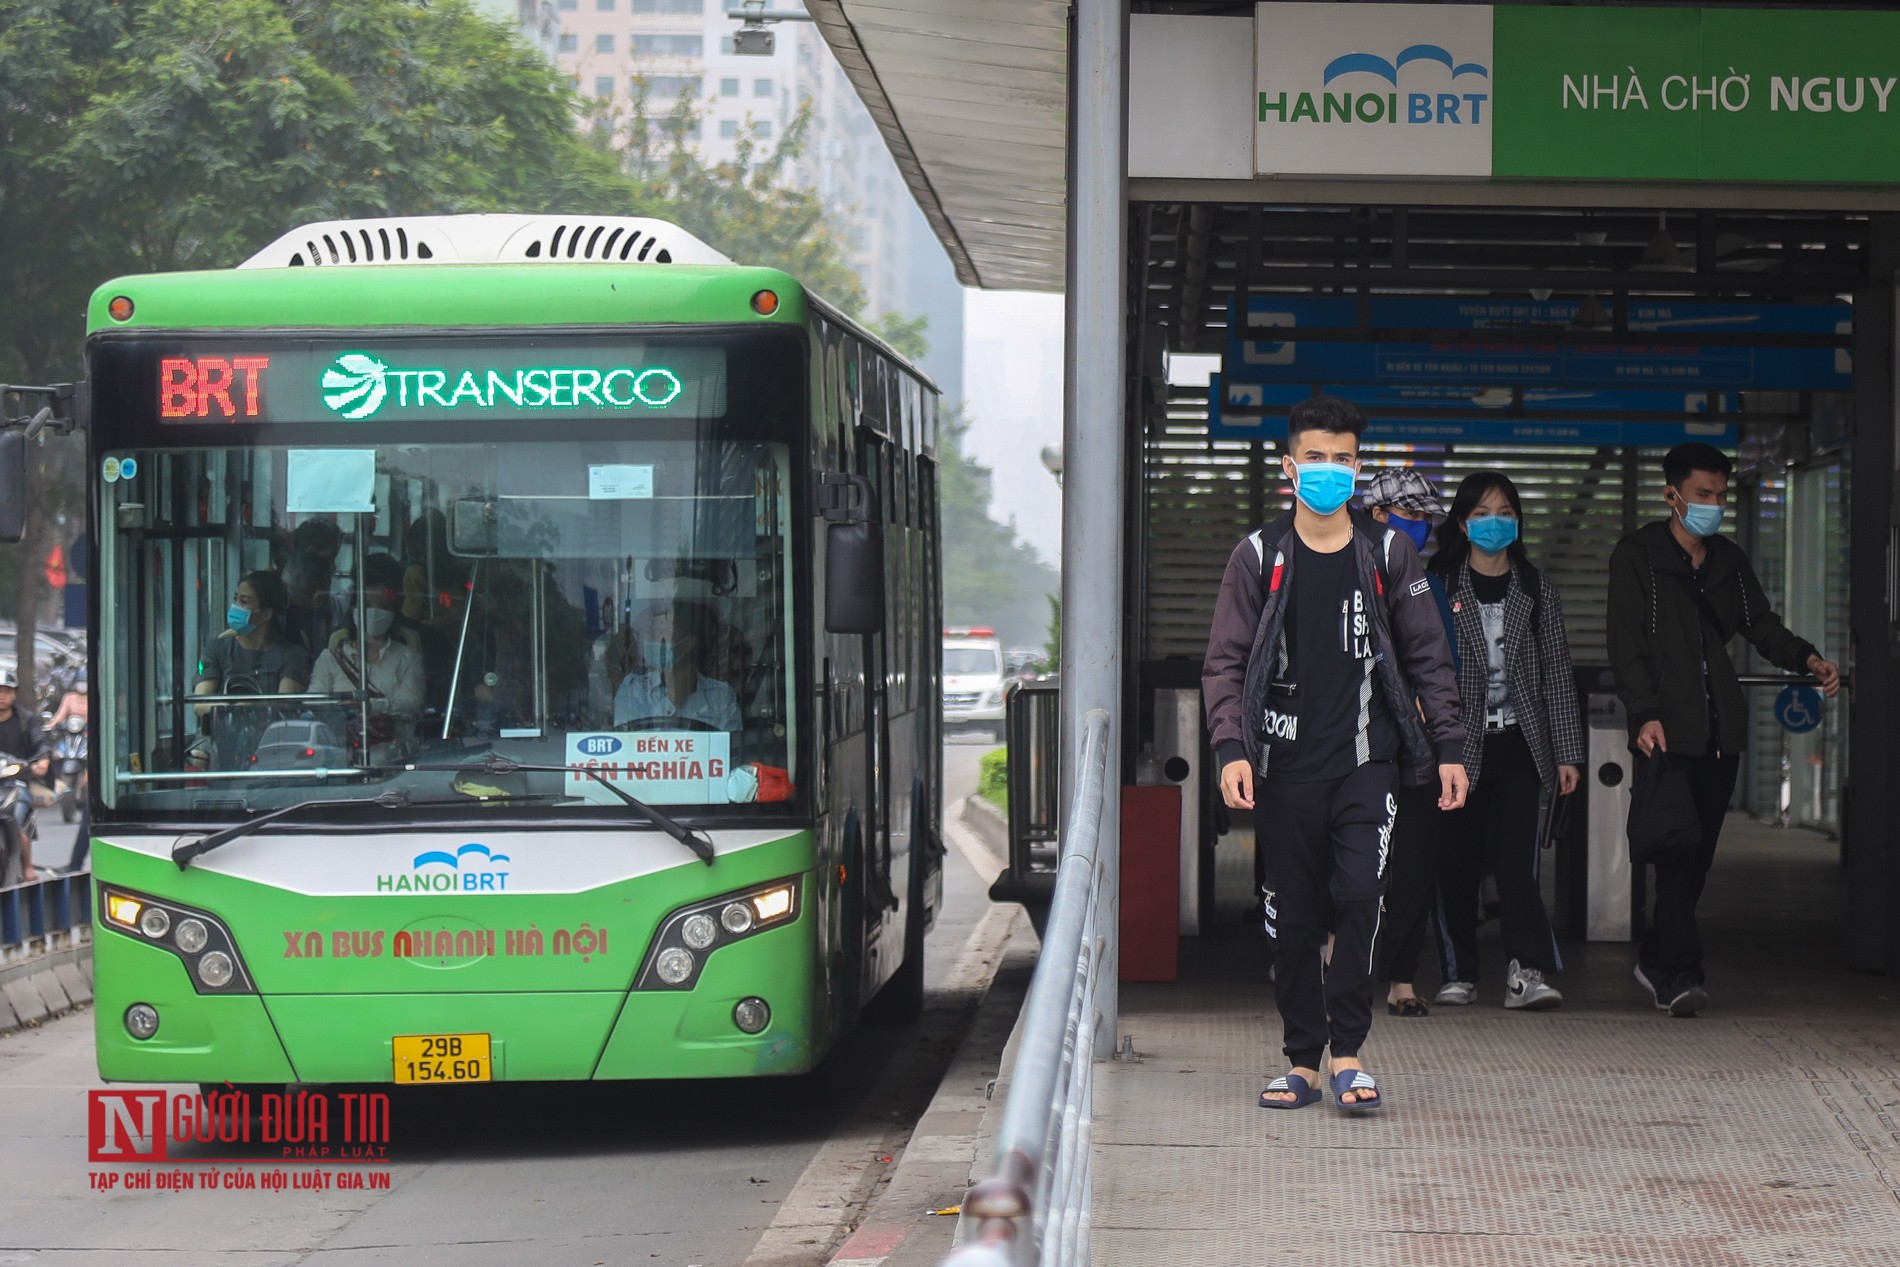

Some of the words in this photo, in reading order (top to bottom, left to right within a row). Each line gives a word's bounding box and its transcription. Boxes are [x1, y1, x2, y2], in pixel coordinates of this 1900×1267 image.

[1562, 66, 1648, 110] NHÀ
[1661, 72, 1751, 113] CHỜ
[1770, 76, 1898, 113] NGUY
[1259, 92, 1397, 124] HANOI
[1407, 92, 1488, 124] BRT
[160, 356, 268, 418] BRT
[384, 367, 682, 410] TRANSERCO
[587, 738, 614, 753] BRT
[636, 735, 669, 752] BẾN
[674, 739, 694, 752] XE
[627, 756, 703, 780] NGHĨA
[377, 873, 458, 892] HANOI
[463, 872, 509, 891] BRT
[332, 930, 385, 958] BUS
[393, 929, 495, 958] NHANH
[505, 923, 544, 956] HÀ
[553, 922, 607, 964] NỘI
[421, 1038, 463, 1058] 29B
[407, 1059, 481, 1081] 154.60
